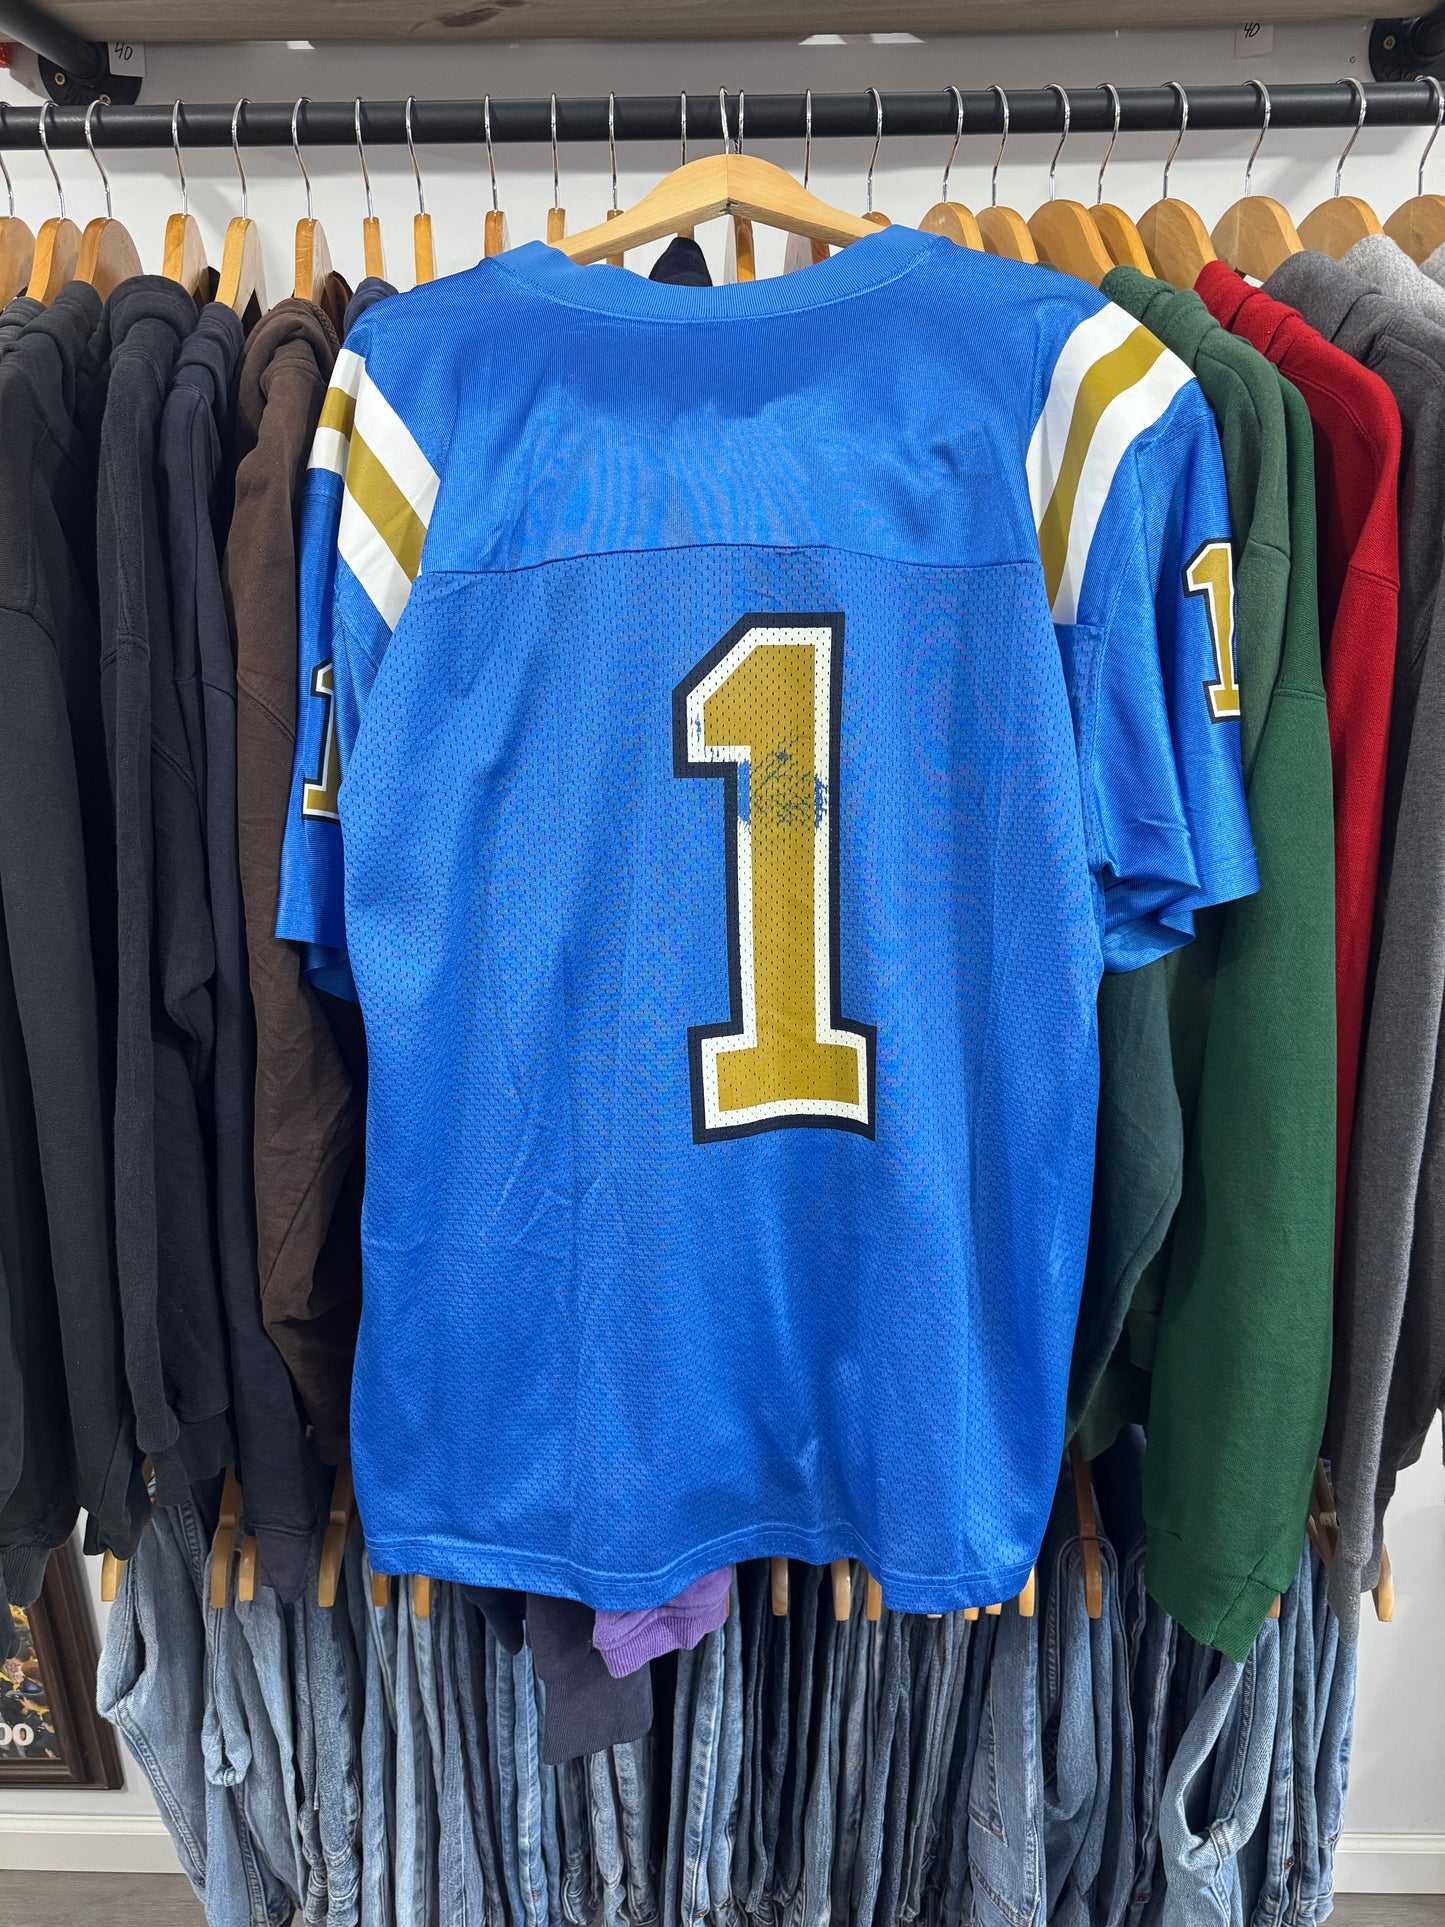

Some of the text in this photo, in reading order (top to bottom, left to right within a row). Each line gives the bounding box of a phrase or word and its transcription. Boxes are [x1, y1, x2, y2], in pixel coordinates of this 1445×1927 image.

[115, 42, 133, 60] 40
[1244, 23, 1260, 38] 40
[1181, 537, 1240, 724] 1
[672, 612, 877, 1144] 1
